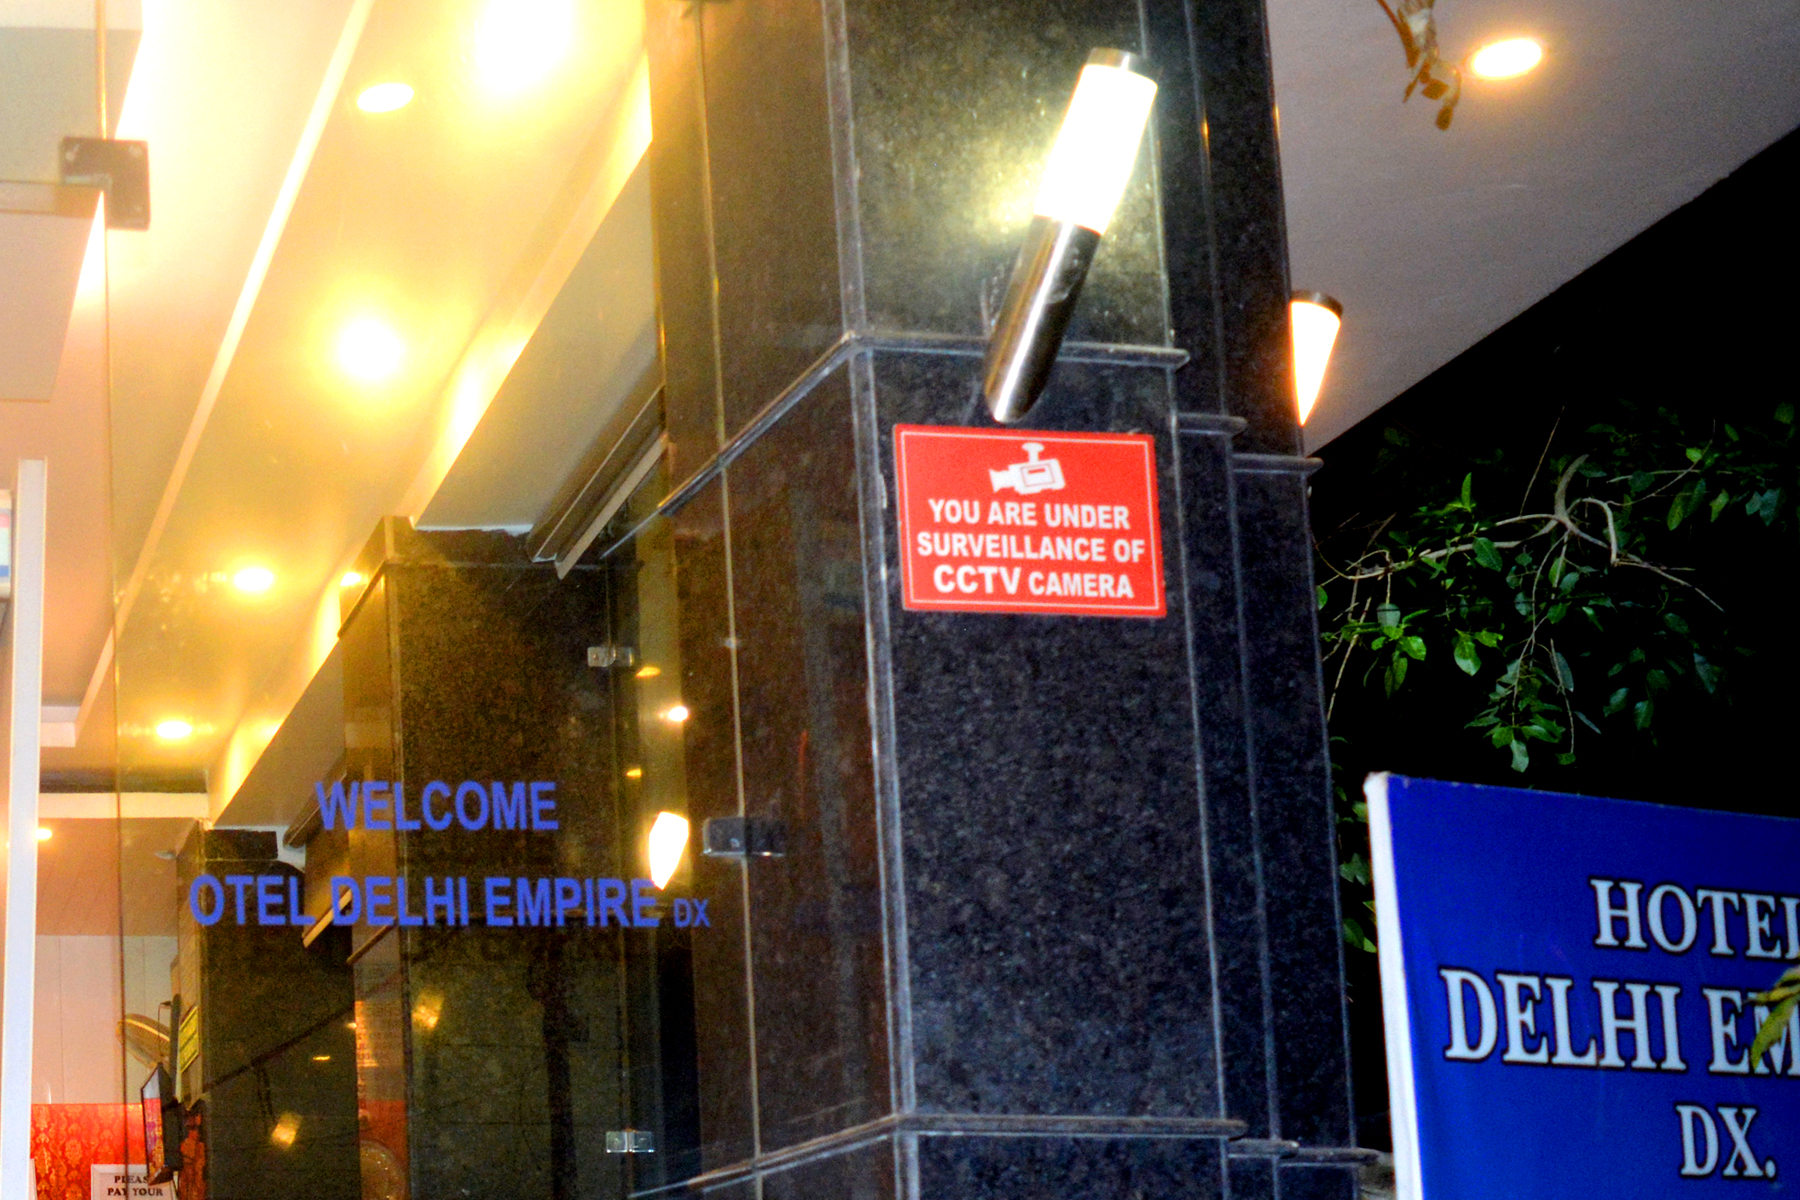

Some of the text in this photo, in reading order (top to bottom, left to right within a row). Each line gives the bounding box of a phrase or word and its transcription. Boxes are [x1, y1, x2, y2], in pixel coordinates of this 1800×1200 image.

[928, 498, 1131, 529] YOU ARE UNDER
[916, 532, 1146, 563] SURVEILLANCE OF
[933, 565, 1134, 598] CCTV CAMERA
[315, 780, 559, 831] WELCOME
[188, 874, 711, 928] OTEL DELHI EMPIRE DX
[1439, 968, 1687, 1071] DELHI
[1675, 1105, 1777, 1179] DX.
[107, 1188, 163, 1196] PAY YOUR
[114, 1175, 149, 1184] PLEAS
